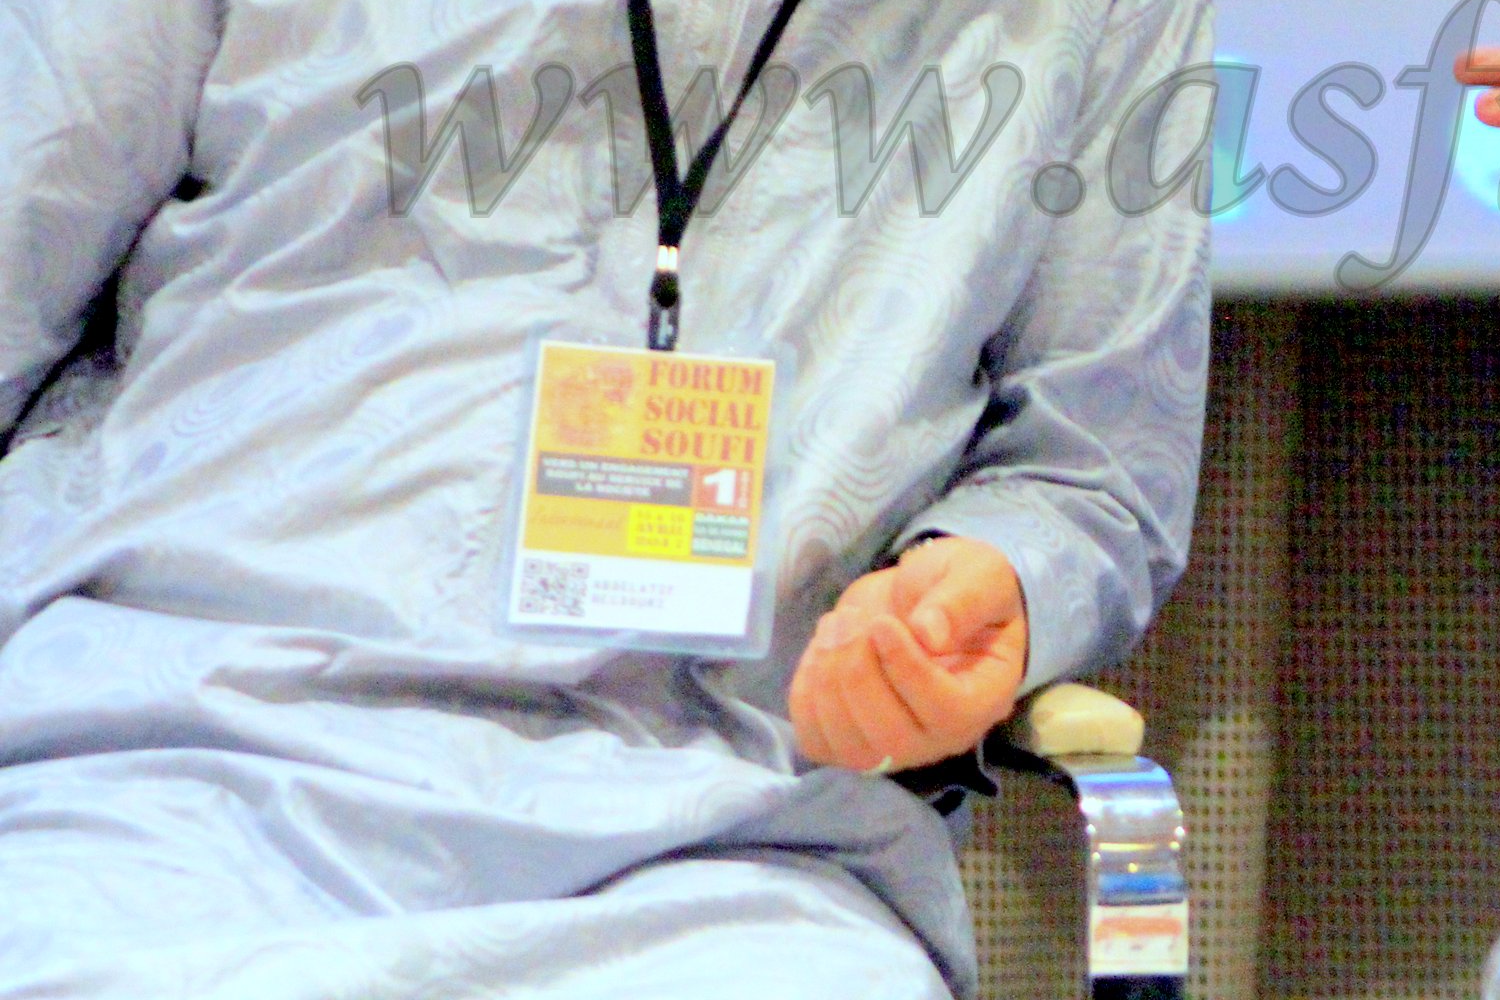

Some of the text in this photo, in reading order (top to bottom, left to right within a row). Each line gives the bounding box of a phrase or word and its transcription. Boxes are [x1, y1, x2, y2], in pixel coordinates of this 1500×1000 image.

[648, 358, 764, 396] FORUM
[643, 394, 762, 431] SOCIAL
[639, 427, 756, 463] SOUFI
[703, 468, 738, 506] 1
